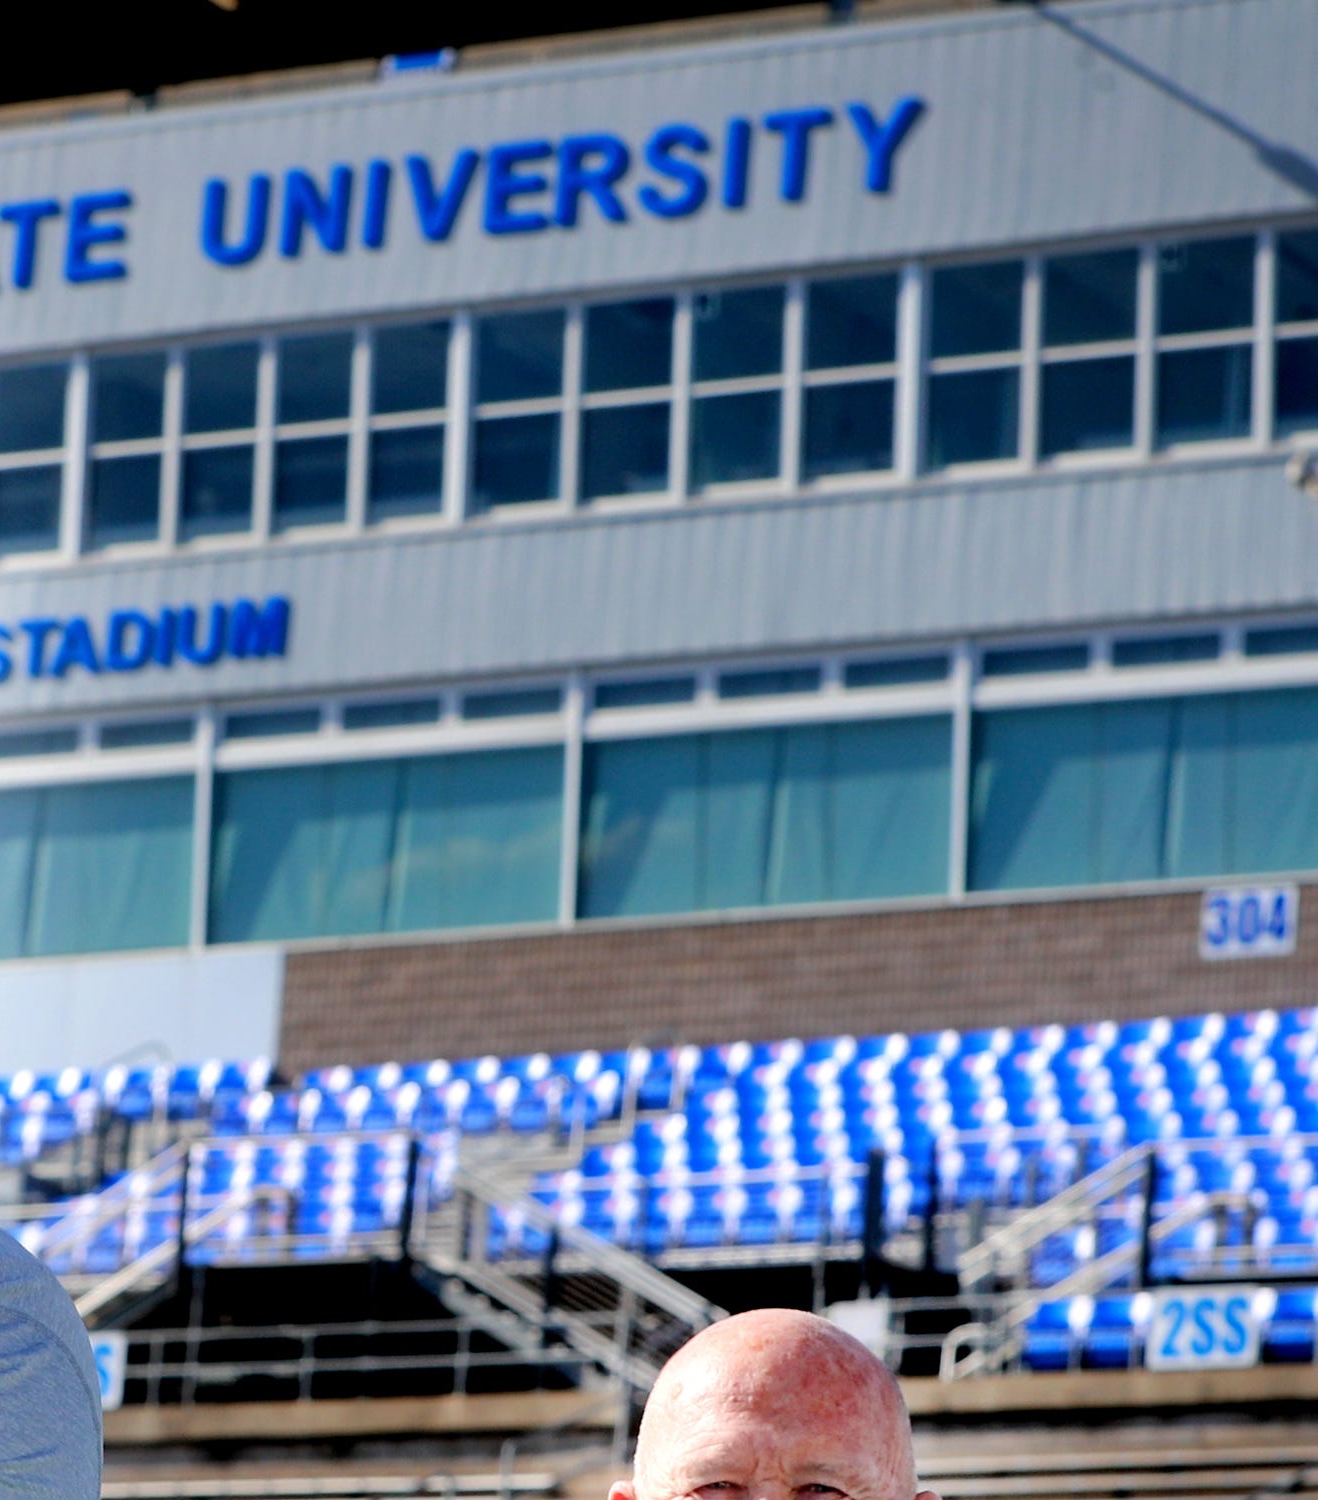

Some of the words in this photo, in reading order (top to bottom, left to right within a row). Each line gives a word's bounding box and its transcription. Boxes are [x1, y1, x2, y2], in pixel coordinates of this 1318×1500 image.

[200, 96, 926, 268] UNIVERSITY
[1208, 894, 1287, 946] 304
[1160, 1296, 1249, 1358] 2SS
